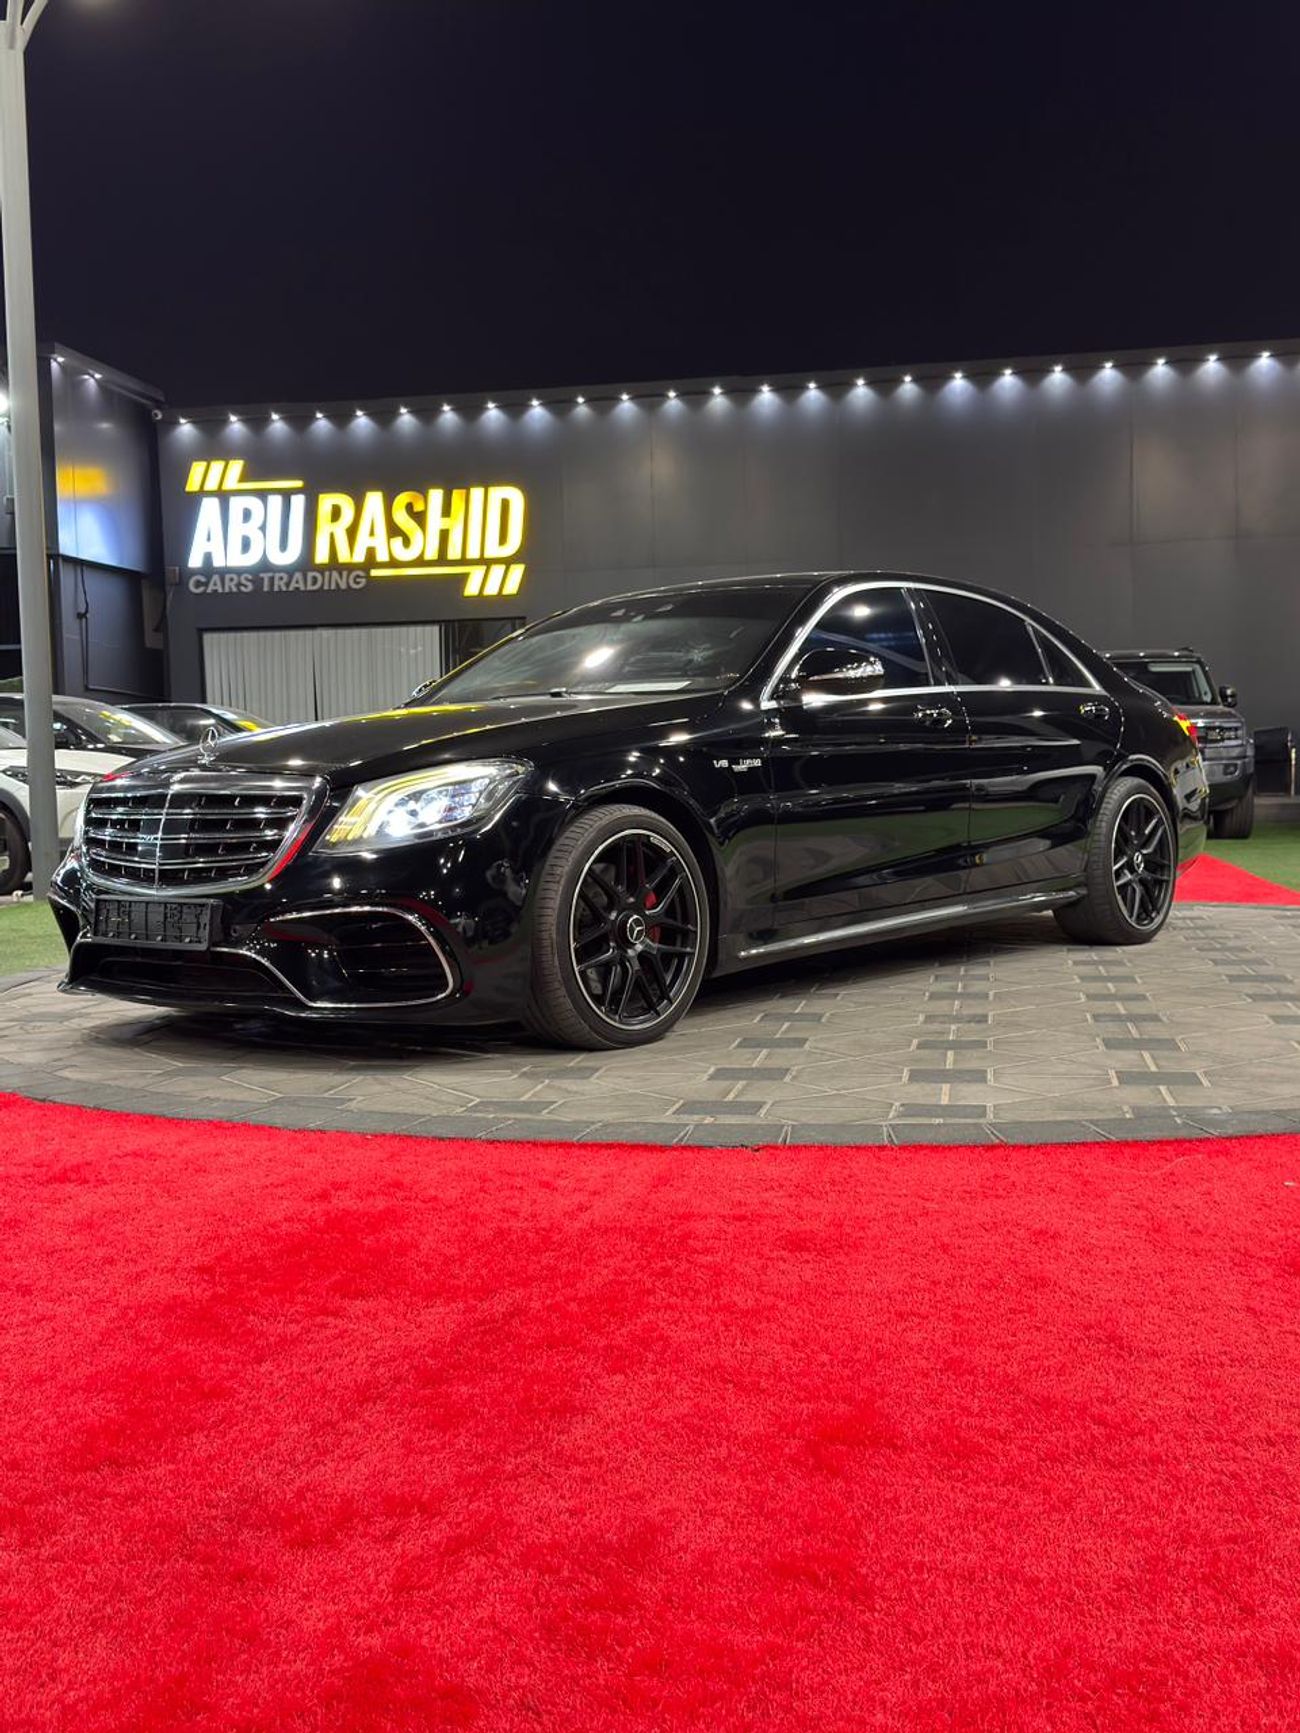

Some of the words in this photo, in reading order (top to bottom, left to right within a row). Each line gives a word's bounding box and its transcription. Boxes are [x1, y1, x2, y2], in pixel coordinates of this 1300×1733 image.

[188, 494, 306, 569] ABU
[314, 486, 526, 565] RASHID
[188, 573, 253, 594] CARS
[259, 570, 367, 592] TRADING
